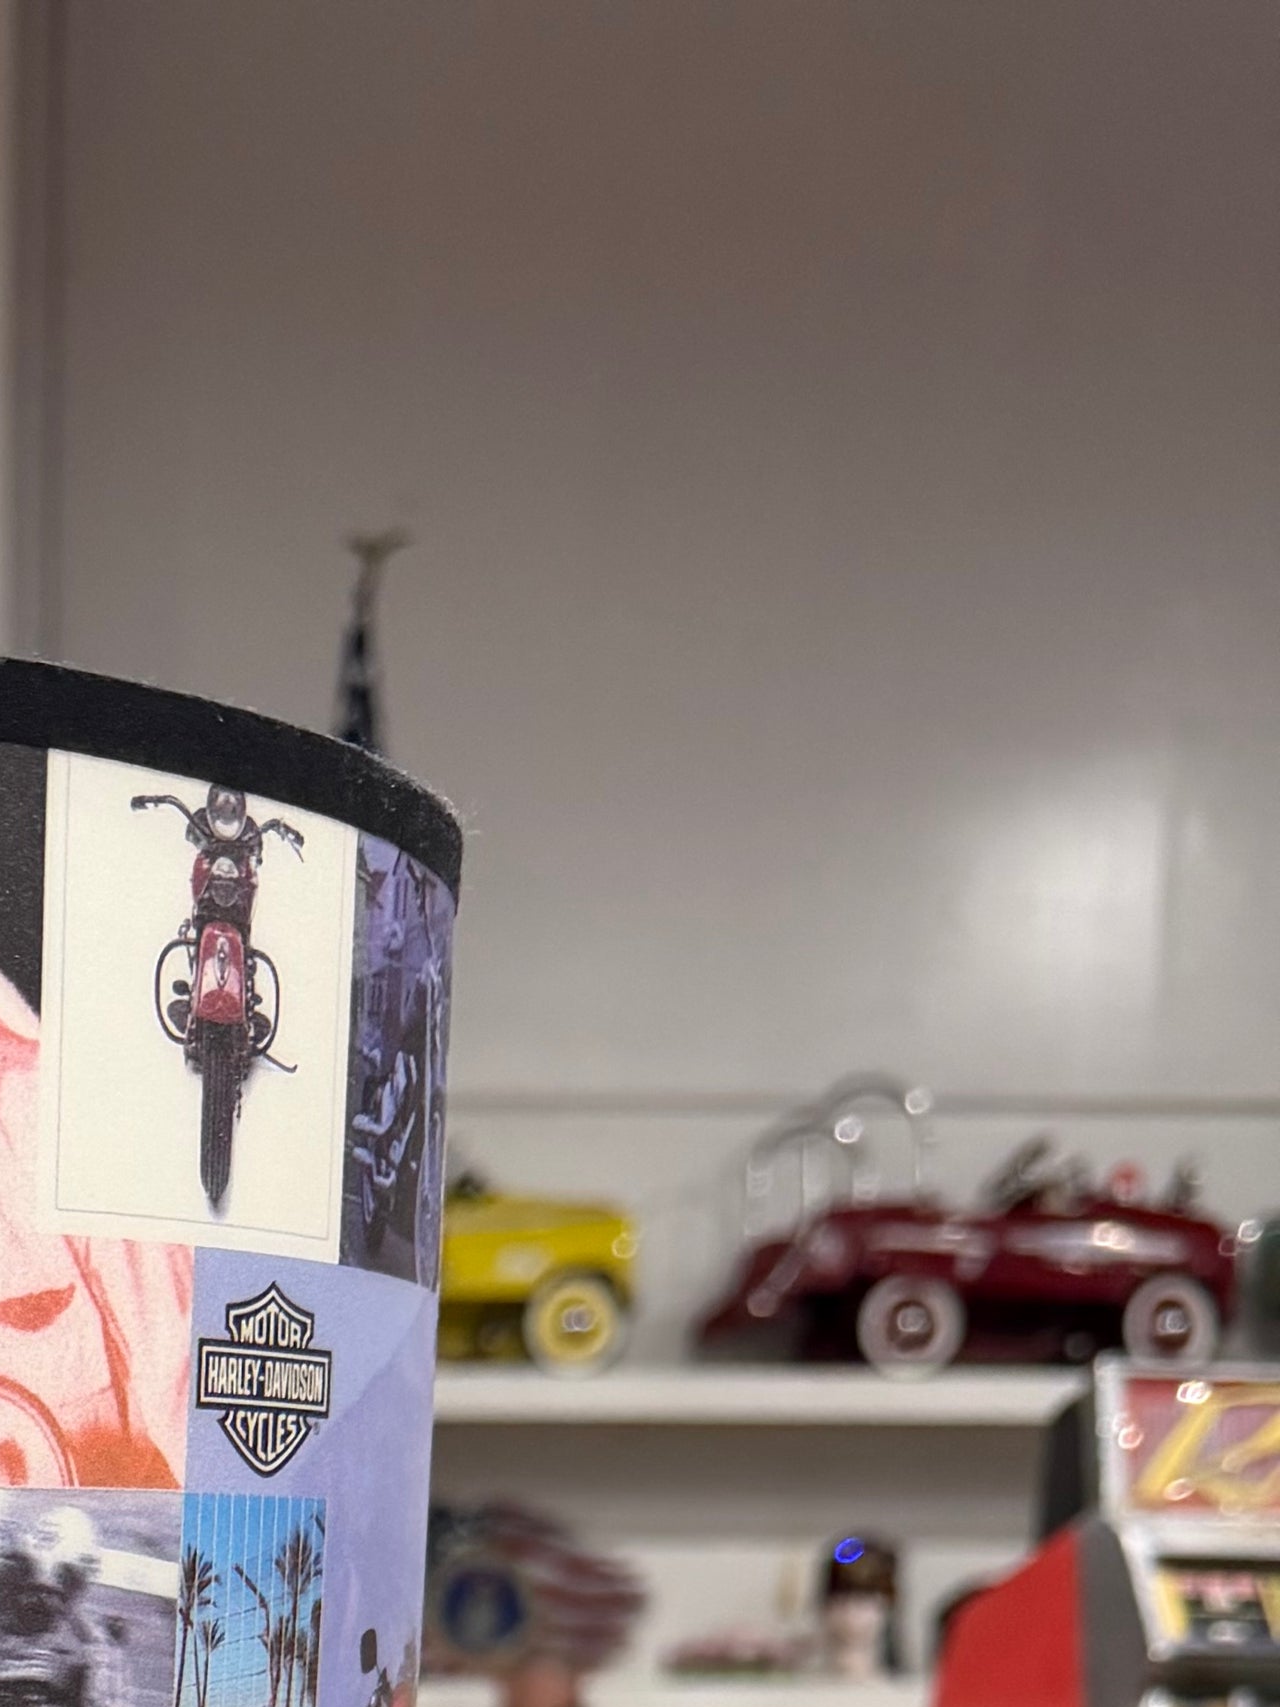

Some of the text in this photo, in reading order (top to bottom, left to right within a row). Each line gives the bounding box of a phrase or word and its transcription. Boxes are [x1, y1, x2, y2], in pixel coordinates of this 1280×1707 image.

[240, 1301, 301, 1349] MOTOR
[207, 1355, 324, 1403] HARLEY-DAVIDSON
[235, 1409, 298, 1463] CYCLES
